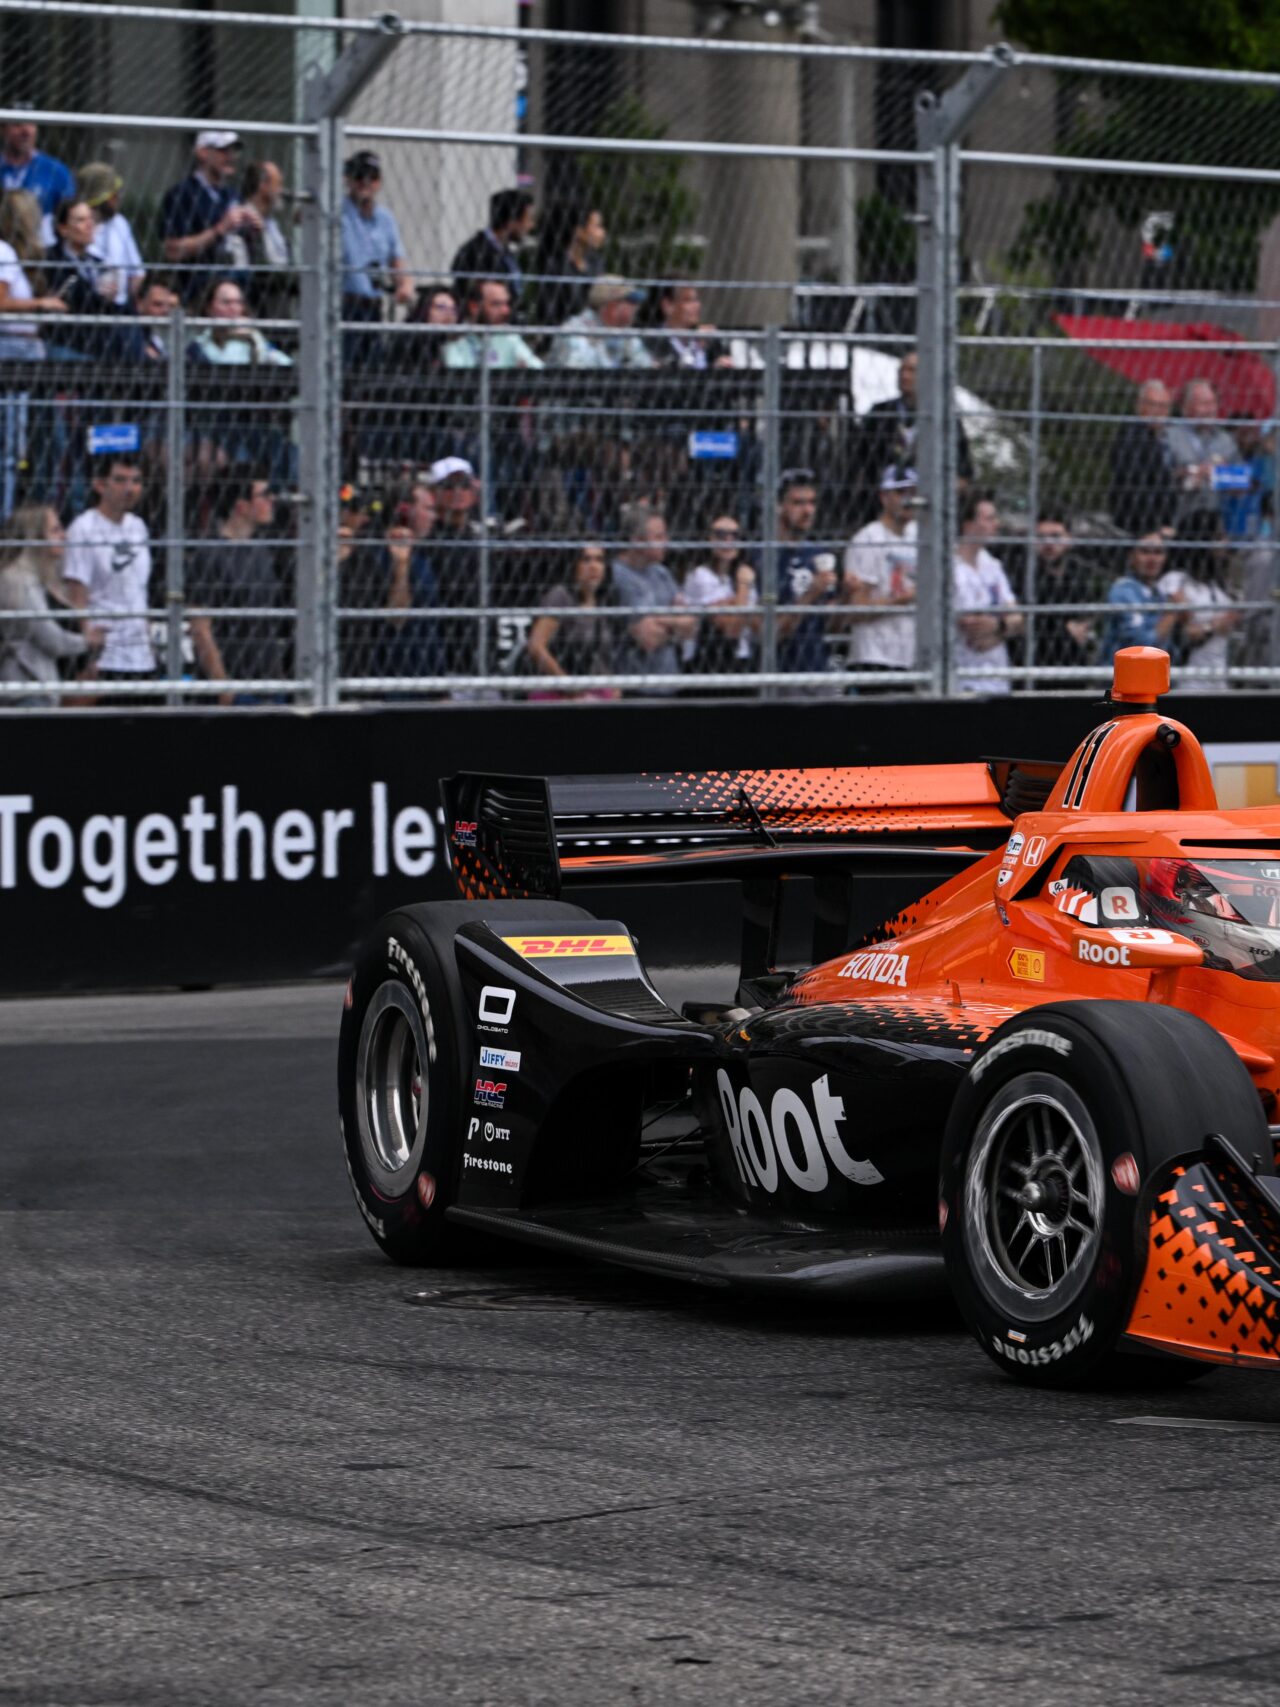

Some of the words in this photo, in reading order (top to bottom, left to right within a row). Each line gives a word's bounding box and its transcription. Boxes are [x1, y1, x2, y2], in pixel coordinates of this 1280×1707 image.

[1061, 721, 1120, 809] 11
[0, 785, 354, 908] Together
[371, 780, 452, 877] le
[1111, 895, 1130, 915] R
[521, 939, 616, 955] DHL
[1078, 939, 1131, 966] Root
[837, 952, 910, 987] HONDA
[482, 1049, 505, 1066] JIFFY
[474, 1079, 508, 1105] HRC
[495, 1127, 511, 1140] NTT
[716, 1067, 886, 1193] Root
[463, 1153, 513, 1174] Firestone
